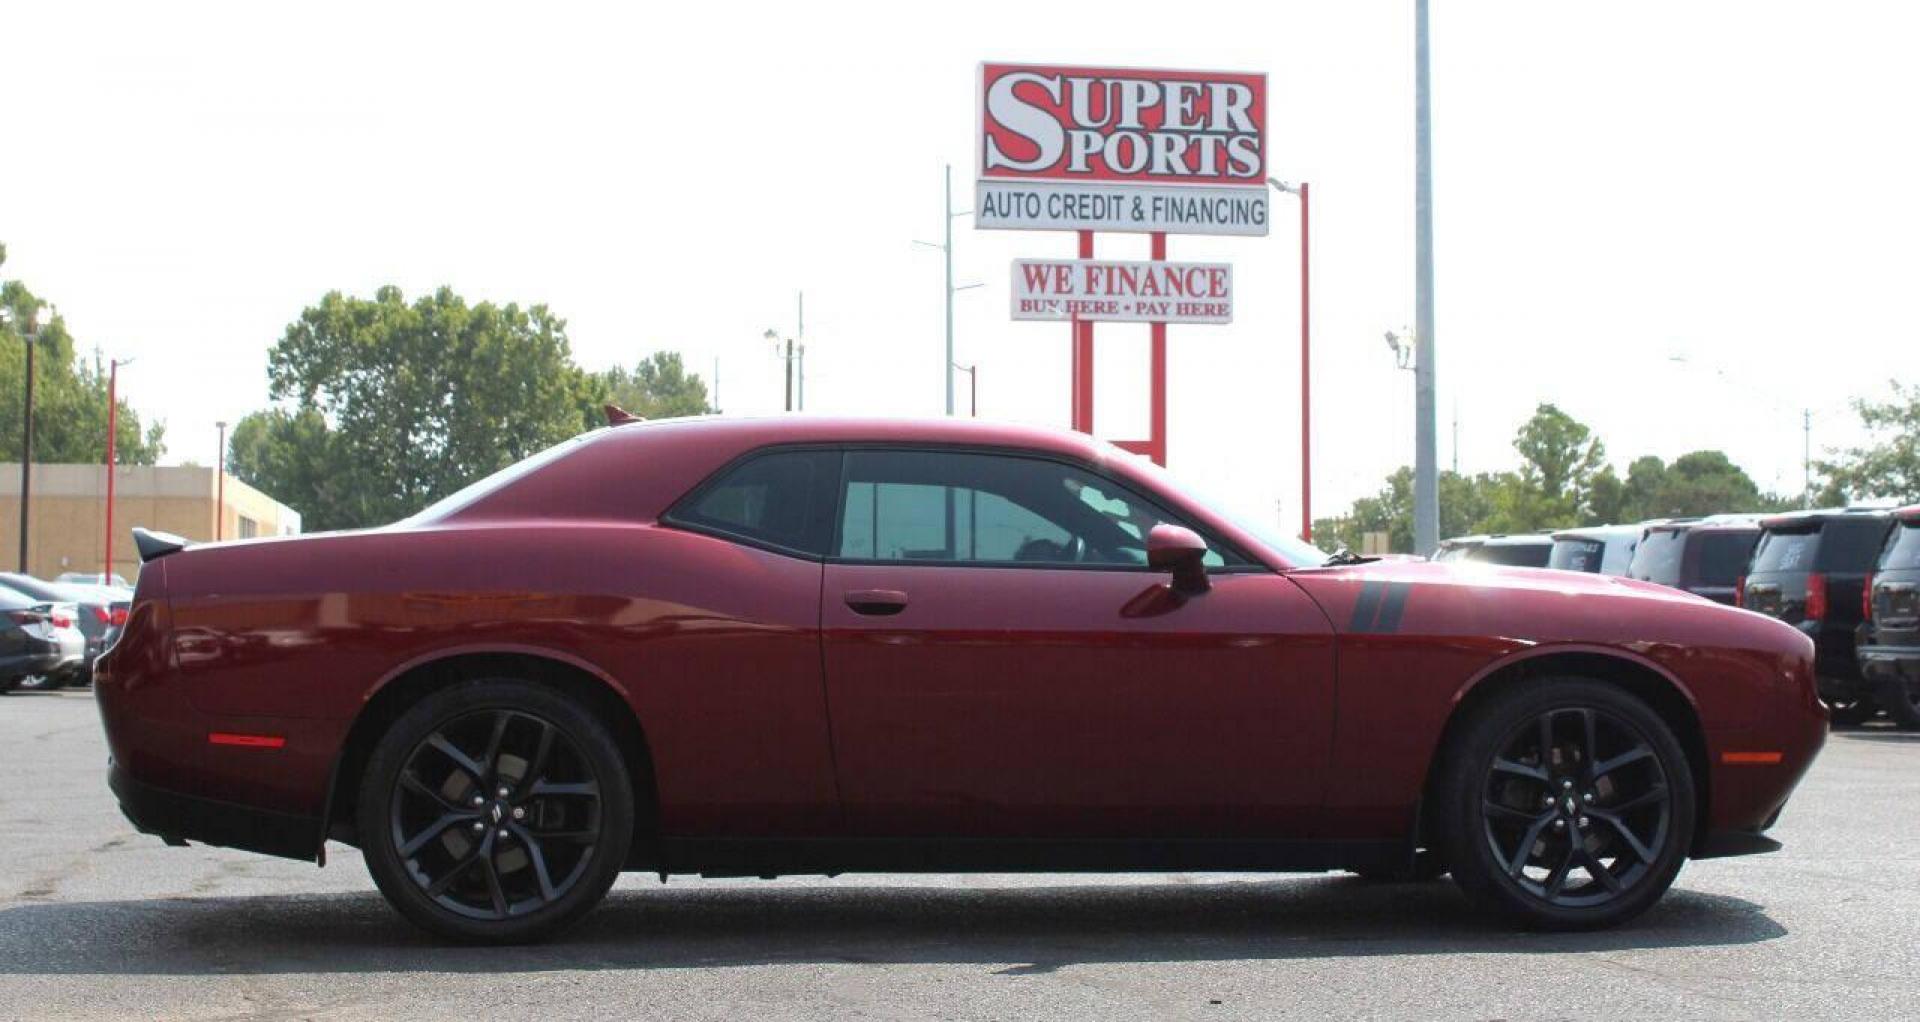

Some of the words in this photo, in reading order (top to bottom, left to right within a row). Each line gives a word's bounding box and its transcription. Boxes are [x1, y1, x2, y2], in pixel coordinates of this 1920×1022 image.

[986, 71, 1258, 172] SUPER
[982, 191, 1040, 219] AUTO
[1047, 194, 1125, 222] CREDIT
[1131, 196, 1145, 221] &
[1152, 197, 1265, 226] FINANCING
[1020, 263, 1075, 294] WE
[1085, 264, 1228, 298] FINANCE
[1066, 300, 1119, 315] HERE
[1136, 301, 1169, 316] PAY
[1176, 302, 1230, 317] HERE
